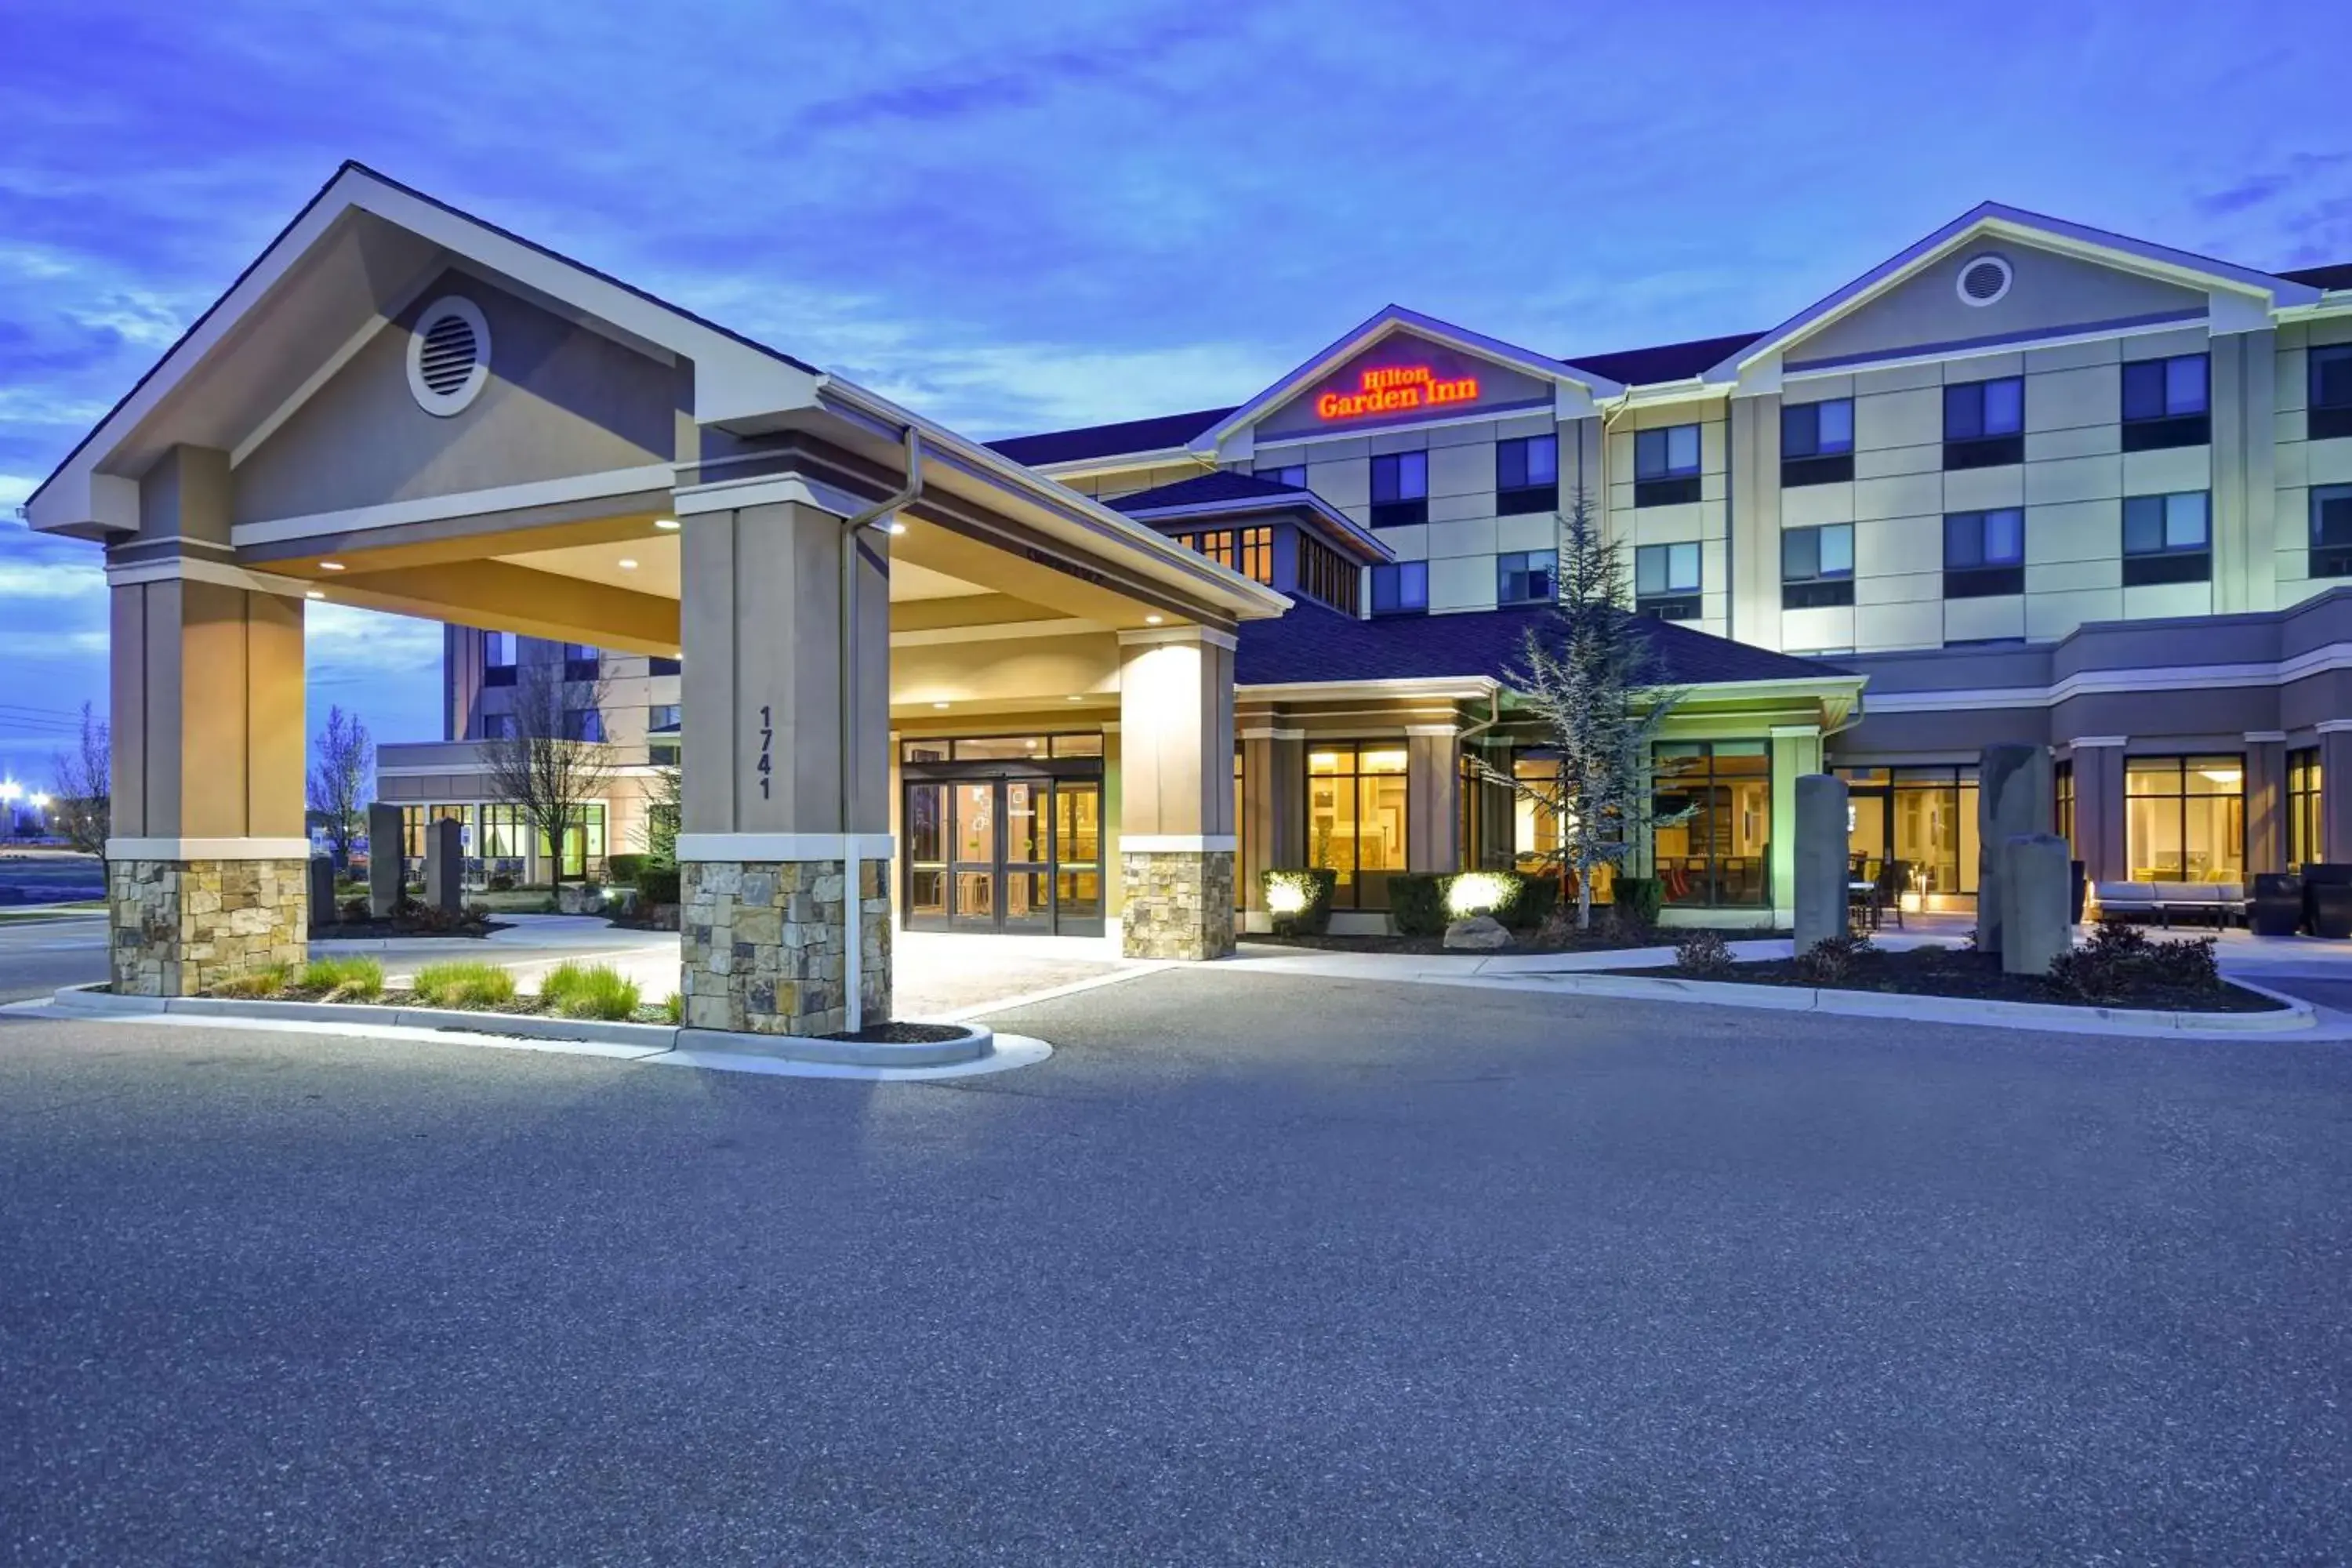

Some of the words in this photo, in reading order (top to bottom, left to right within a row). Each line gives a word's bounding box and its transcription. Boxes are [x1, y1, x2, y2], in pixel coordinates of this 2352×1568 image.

[1319, 387, 1419, 418] Garden
[1425, 377, 1478, 403] Inn
[1363, 366, 1430, 389] Hilton
[757, 706, 772, 800] 1741
